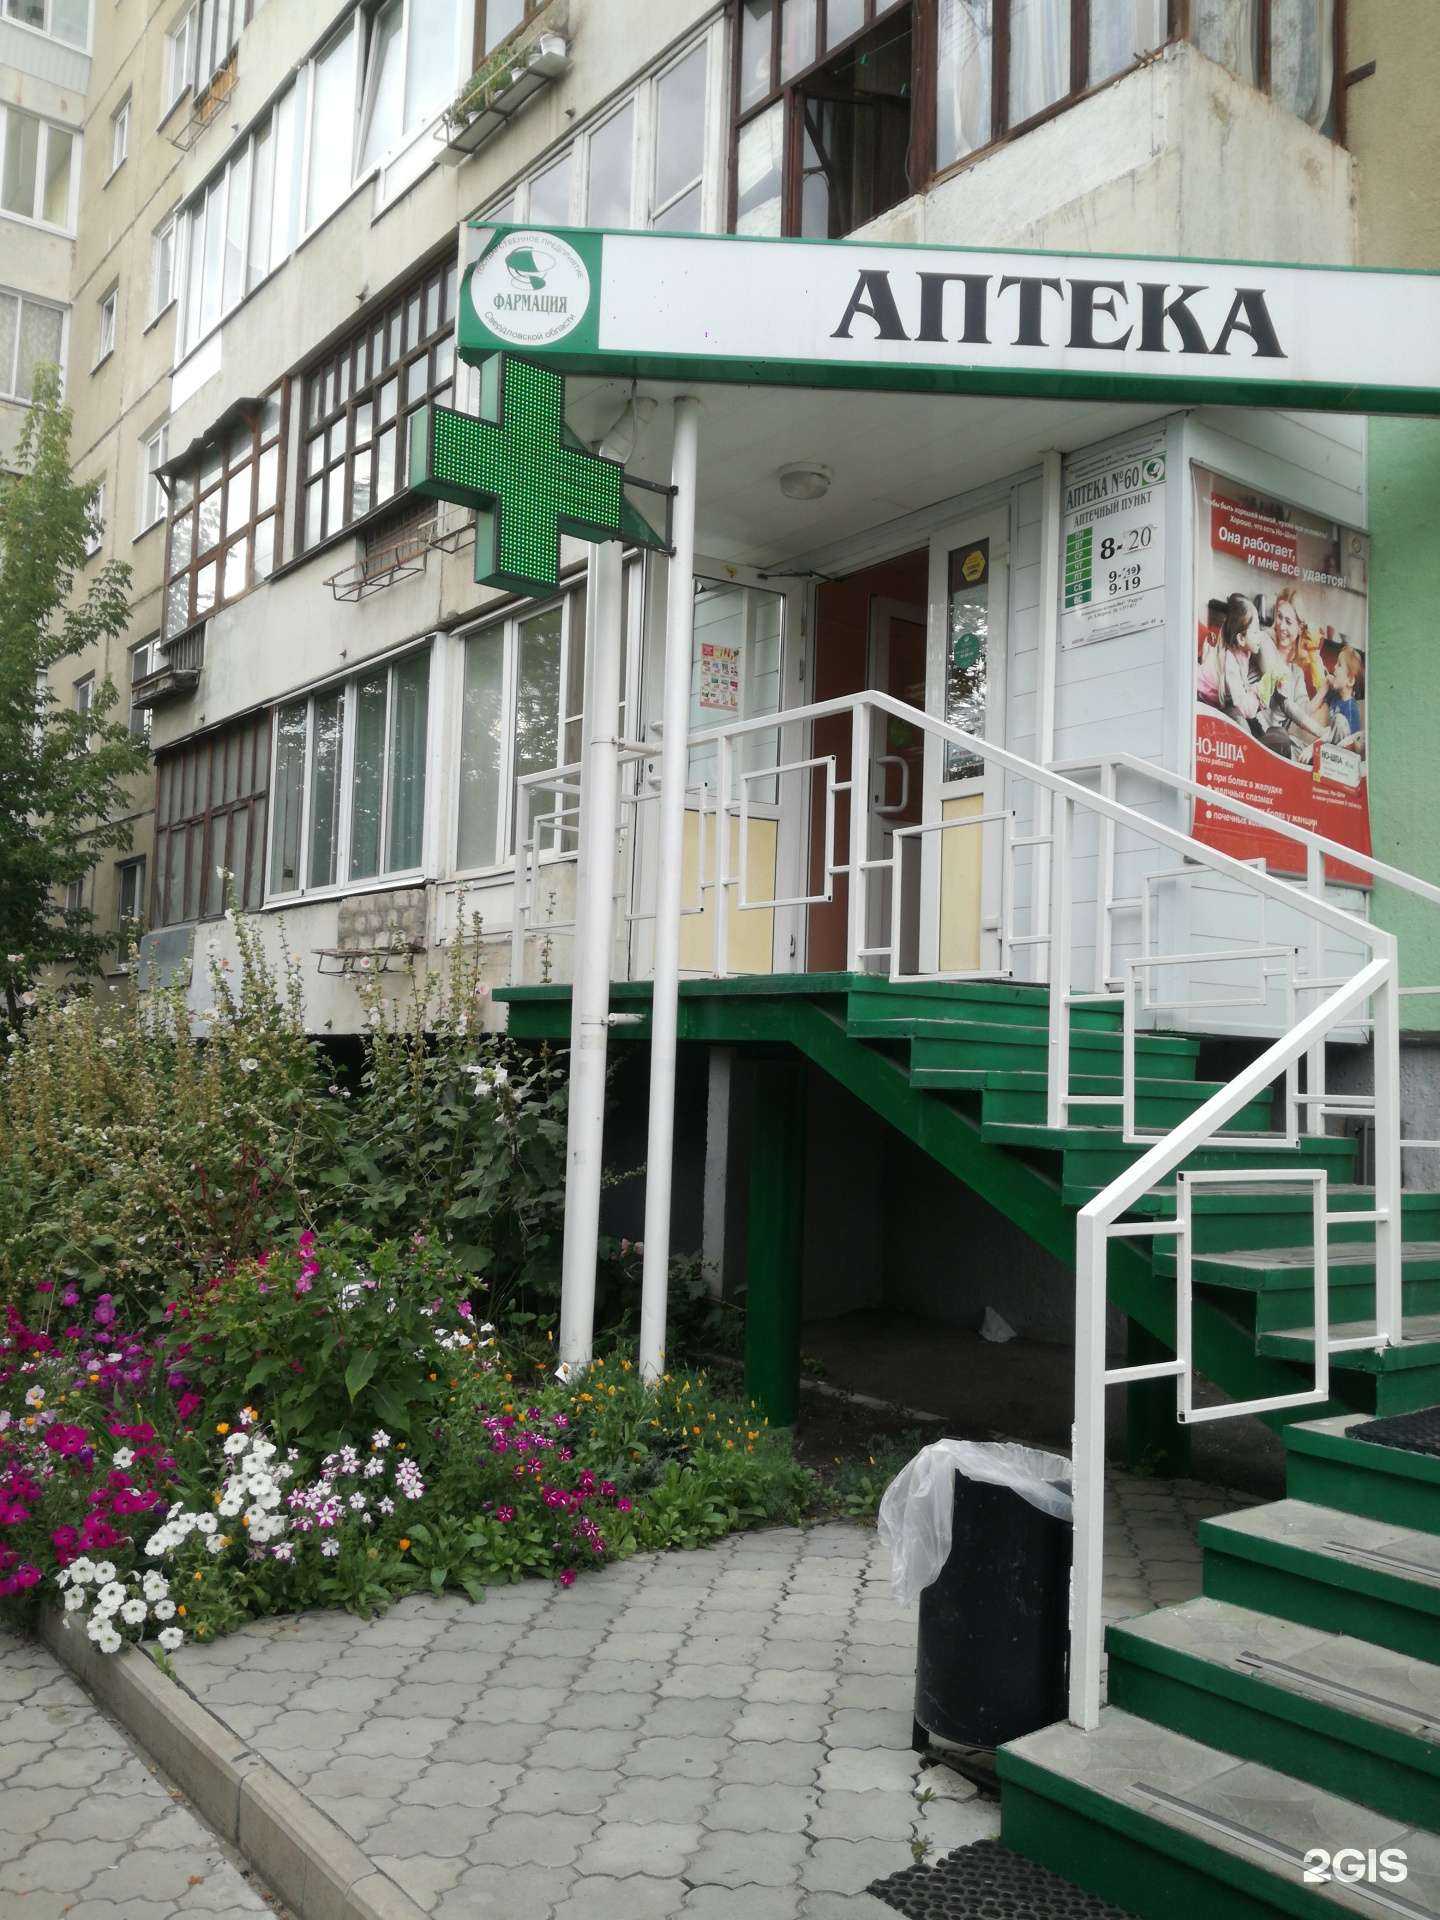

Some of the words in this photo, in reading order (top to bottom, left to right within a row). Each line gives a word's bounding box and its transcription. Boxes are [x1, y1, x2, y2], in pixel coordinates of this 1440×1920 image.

[493, 293, 569, 316] ФАРМАЦИЯ
[829, 268, 1288, 359] АПТЕКА
[545, 313, 577, 338] области
[1066, 477, 1108, 511] АПТЕКА
[1074, 499, 1120, 527] АПТЕЧНЫЙ
[1121, 491, 1152, 511] ПУНКТ
[1219, 526, 1241, 545] Она
[1257, 556, 1280, 571] мне
[1281, 563, 1301, 577] все
[1302, 568, 1348, 588] удается!
[1213, 773, 1227, 784] при
